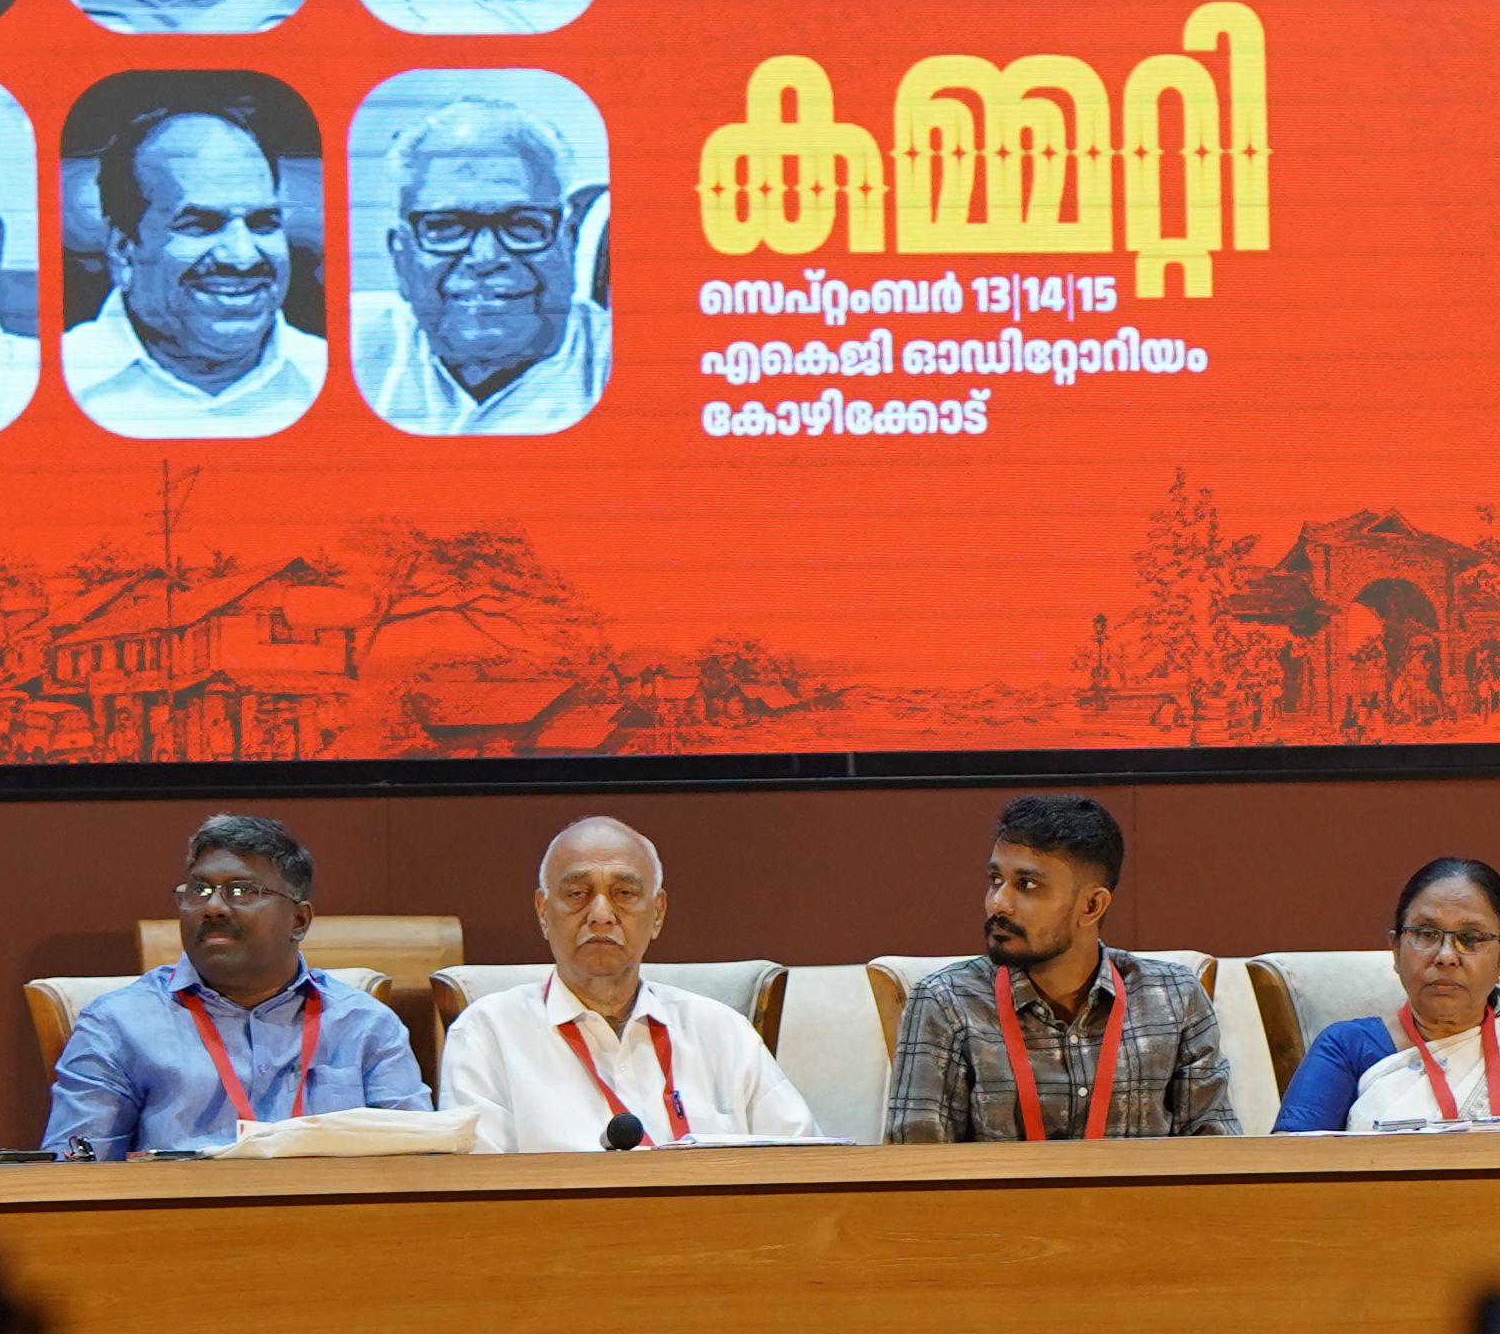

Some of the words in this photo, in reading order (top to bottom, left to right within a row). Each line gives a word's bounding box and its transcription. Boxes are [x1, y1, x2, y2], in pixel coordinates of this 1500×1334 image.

[696, 2, 1272, 299] കമ്മറ്റി
[700, 269, 964, 326] സെപ്റ്റംബർ
[700, 328, 894, 386] എകെജി
[902, 327, 1209, 386] ഓഡിറ്റോറിയം
[701, 388, 992, 437] കോഴിക്കോട്
